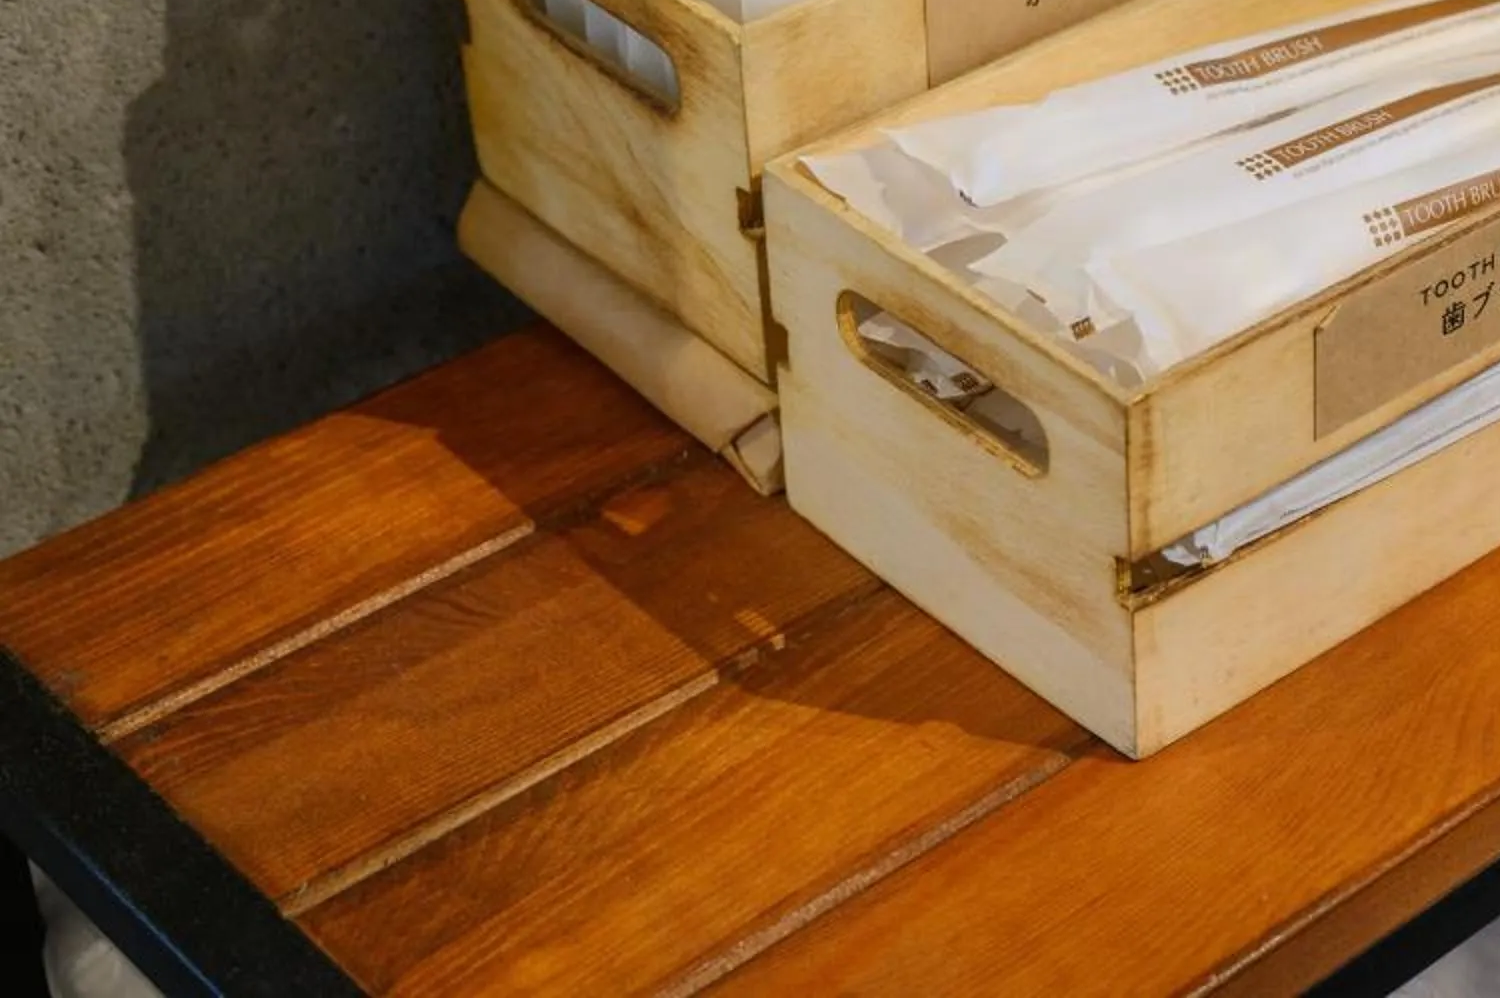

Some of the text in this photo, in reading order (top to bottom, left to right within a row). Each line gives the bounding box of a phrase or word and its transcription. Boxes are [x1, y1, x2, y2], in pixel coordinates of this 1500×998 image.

[1196, 55, 1261, 82] TOOTH
[1262, 35, 1323, 66] BRUSH
[1277, 129, 1339, 160] TOOTH
[1335, 109, 1393, 137] BRUSH
[1404, 189, 1467, 227] TOOTH
[1419, 253, 1495, 306] TOOTH
